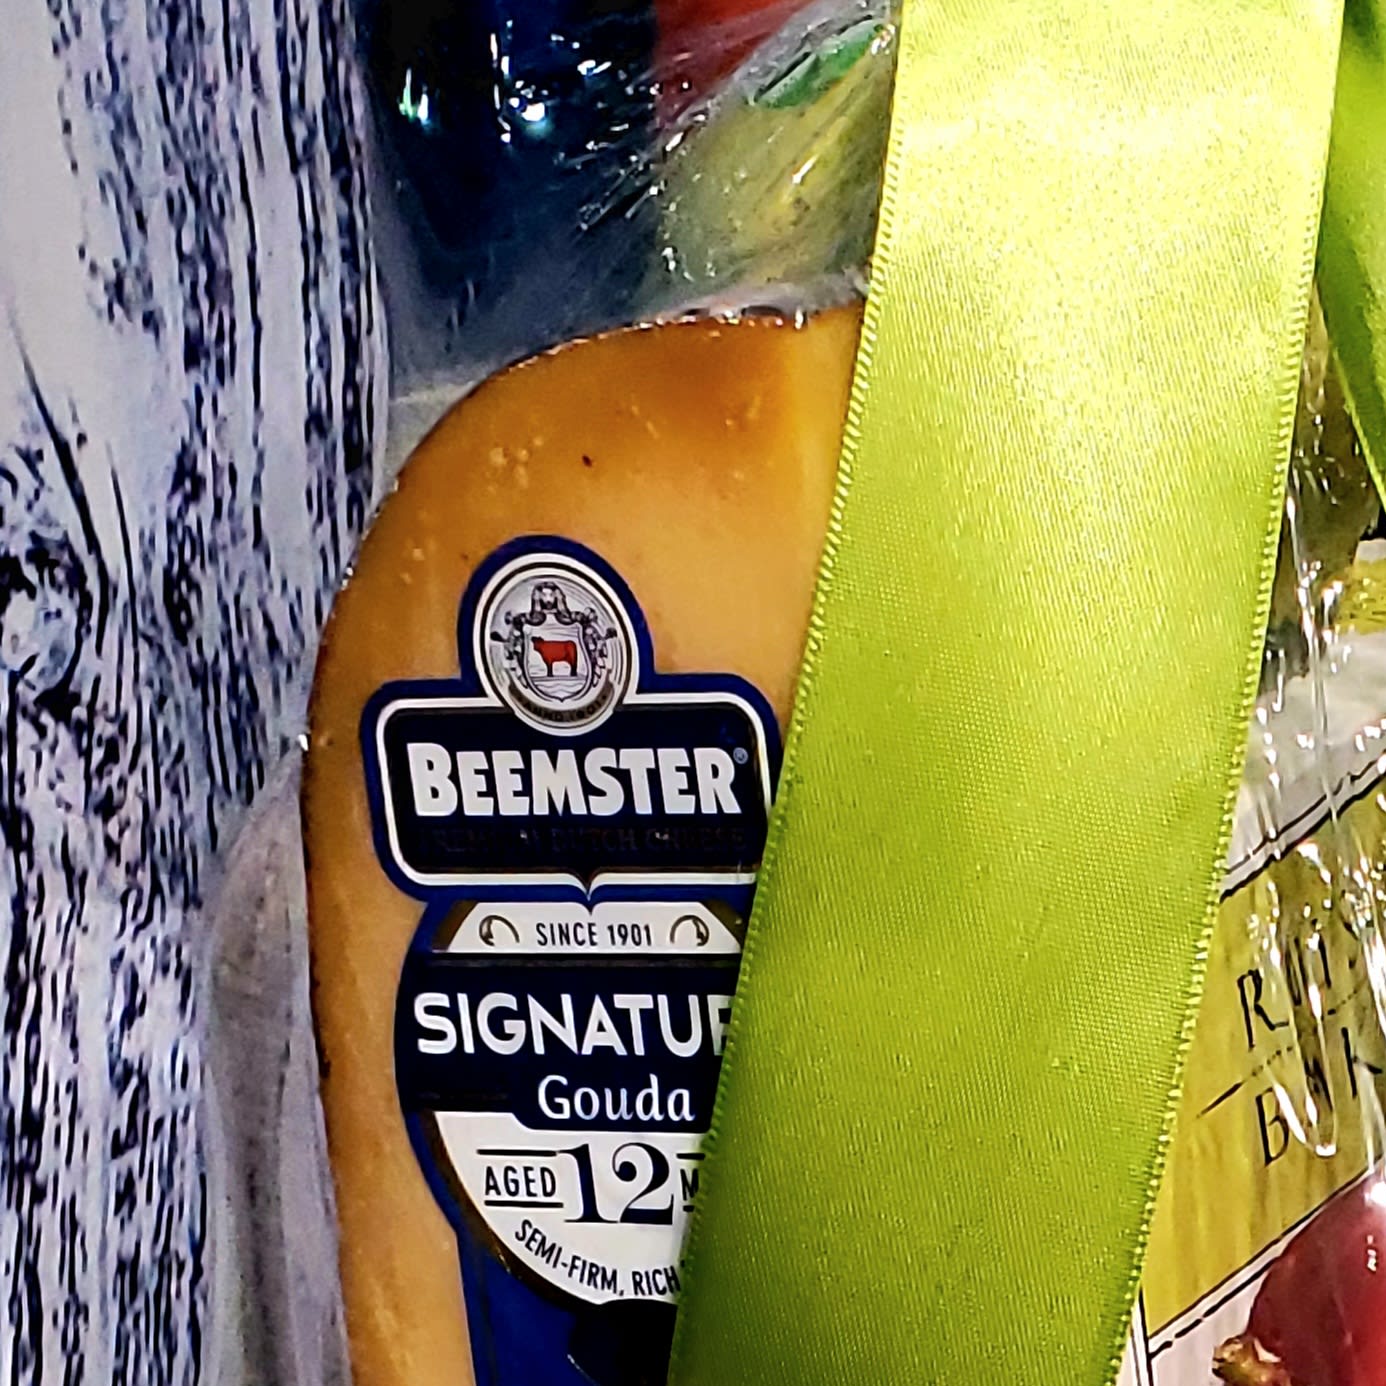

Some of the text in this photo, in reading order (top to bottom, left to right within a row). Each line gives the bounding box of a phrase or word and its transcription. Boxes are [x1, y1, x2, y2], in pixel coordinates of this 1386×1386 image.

[536, 921, 652, 948] SINCE 1901
[537, 1073, 696, 1122] Gouda
[484, 1164, 557, 1198] AGED
[557, 1141, 674, 1226] 12
[514, 1218, 682, 1298] SEMI-FIRM, RICH
